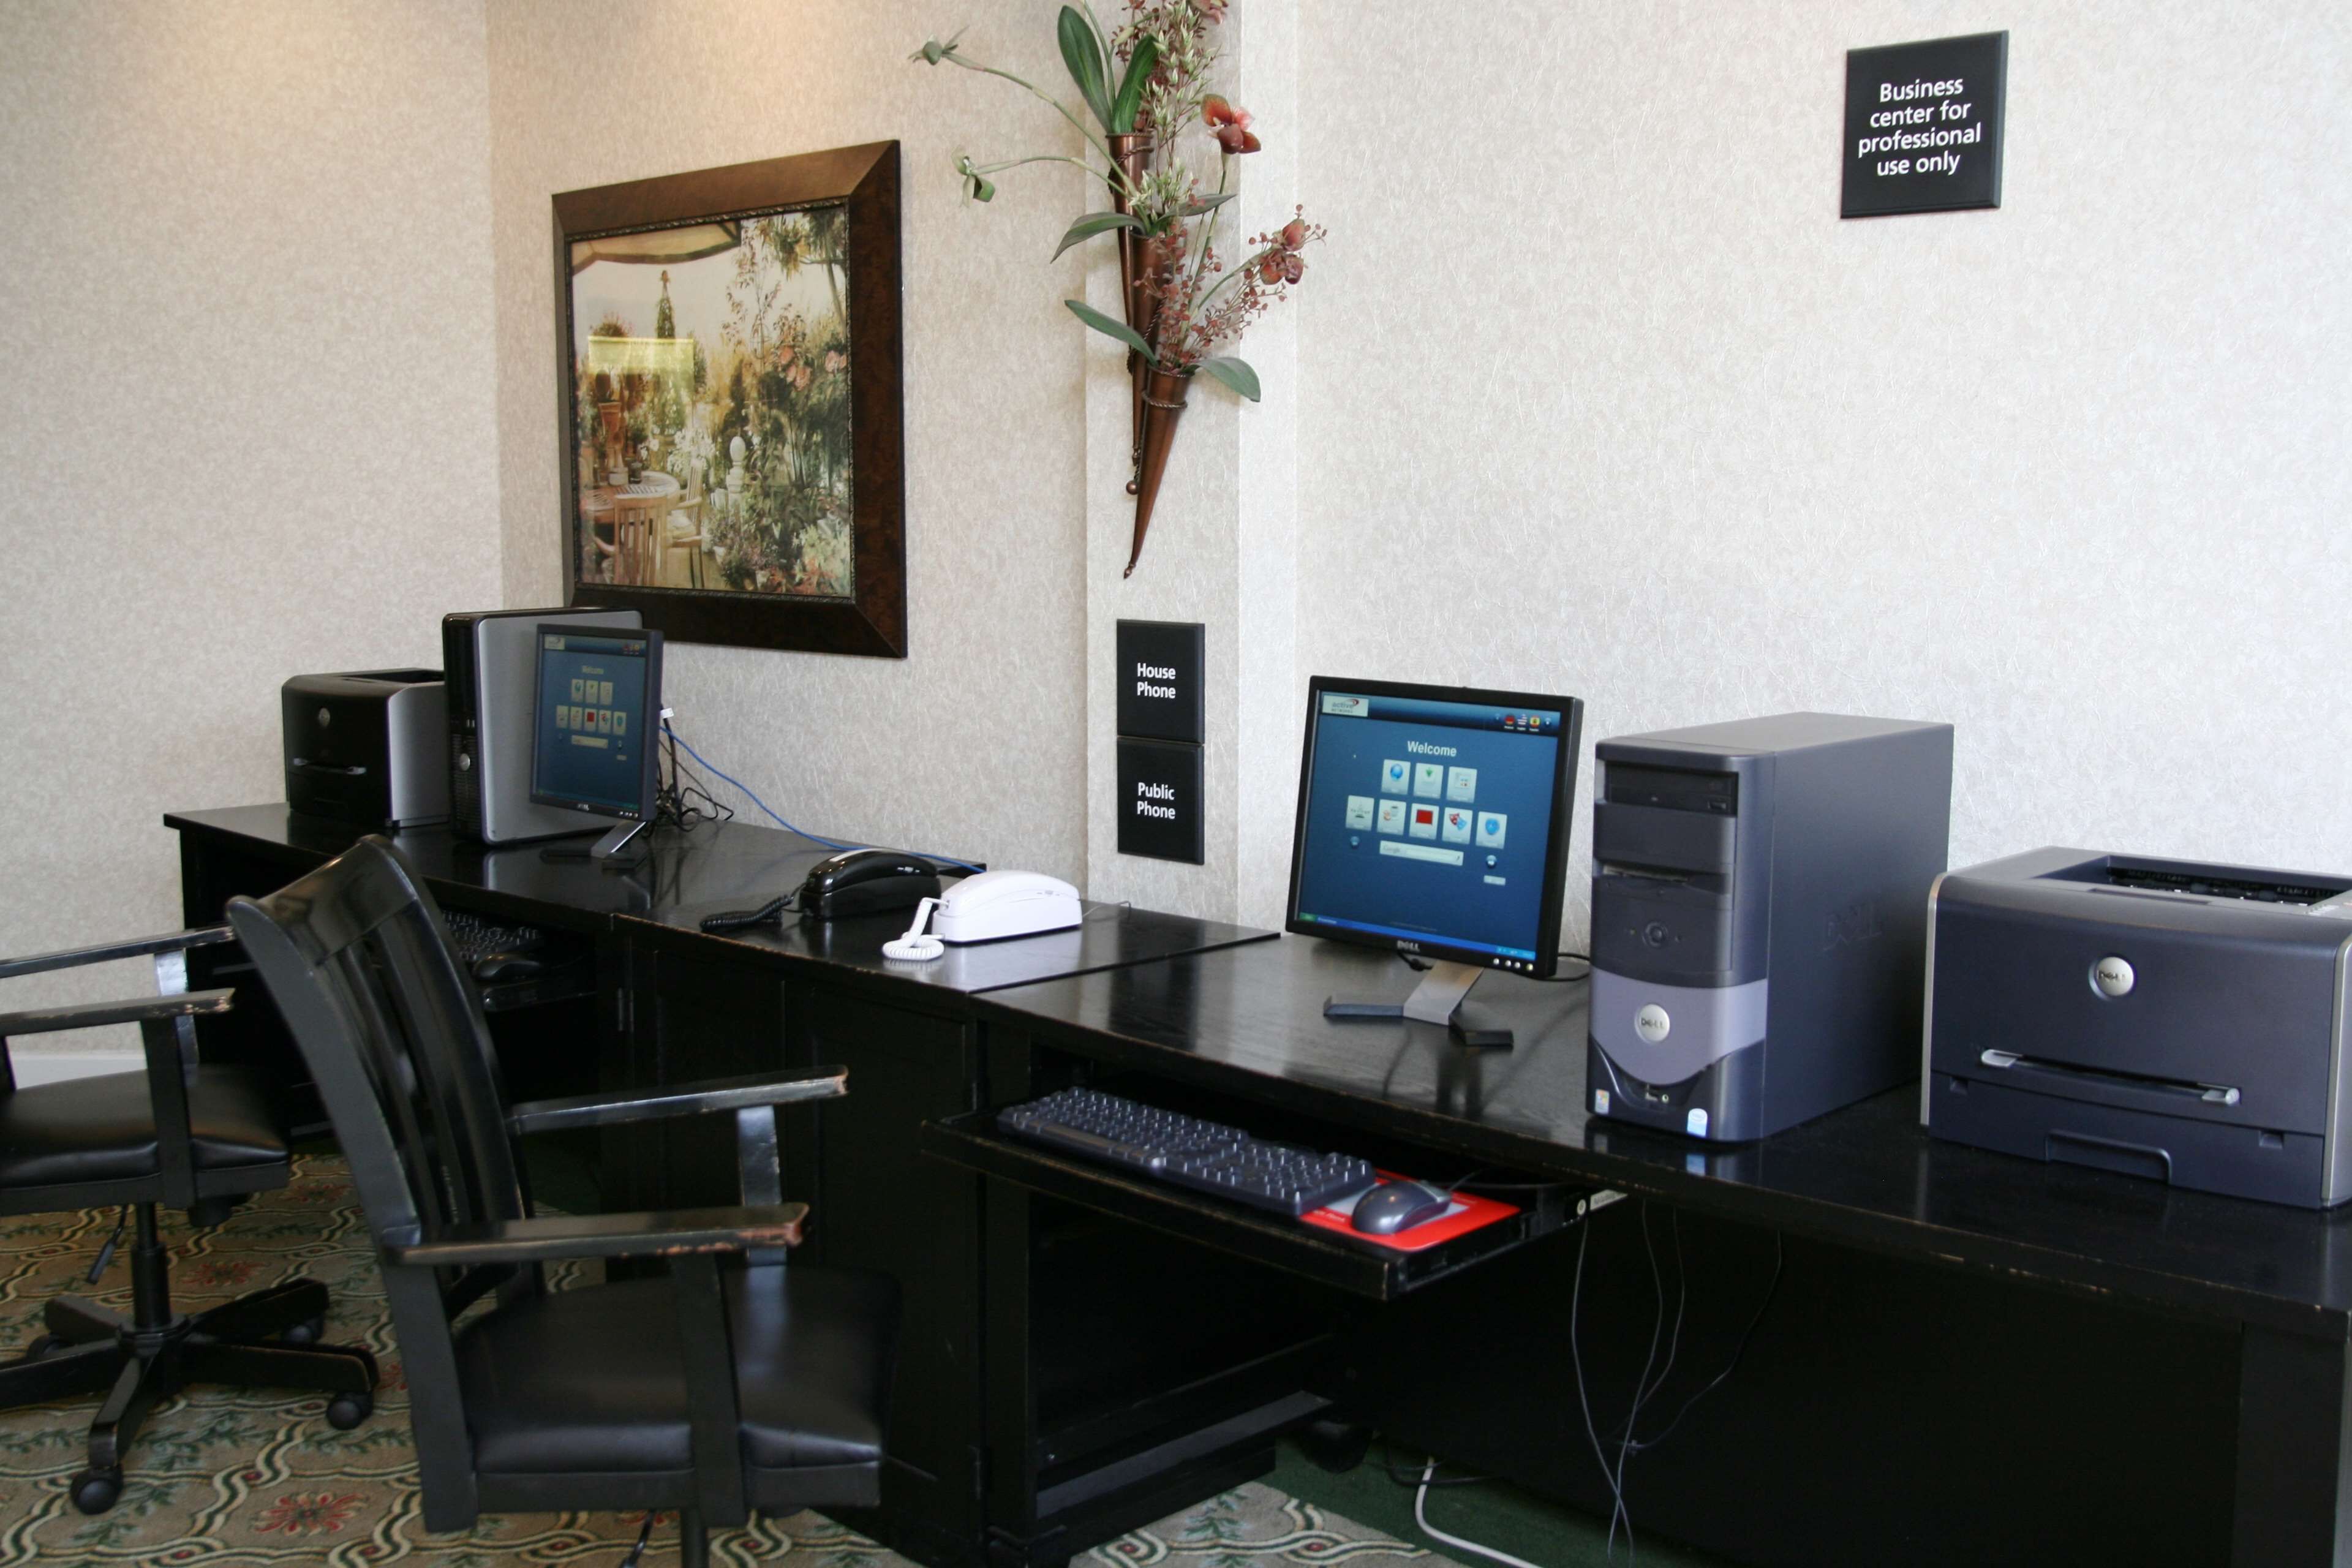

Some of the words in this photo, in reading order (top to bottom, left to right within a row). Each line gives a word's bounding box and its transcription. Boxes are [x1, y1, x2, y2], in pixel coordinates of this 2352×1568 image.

[1880, 78, 1964, 103] Business
[1870, 106, 1935, 128] center
[1939, 99, 1972, 121] for
[1858, 121, 1981, 159] professional
[1877, 159, 1910, 176] use
[1915, 150, 1961, 176] only
[1137, 662, 1176, 680] House
[1137, 681, 1176, 699] Phone
[1407, 741, 1457, 757] Welcome
[1138, 782, 1175, 801] Public
[1137, 801, 1176, 820] Phone
[1641, 1017, 1664, 1029] DELL
